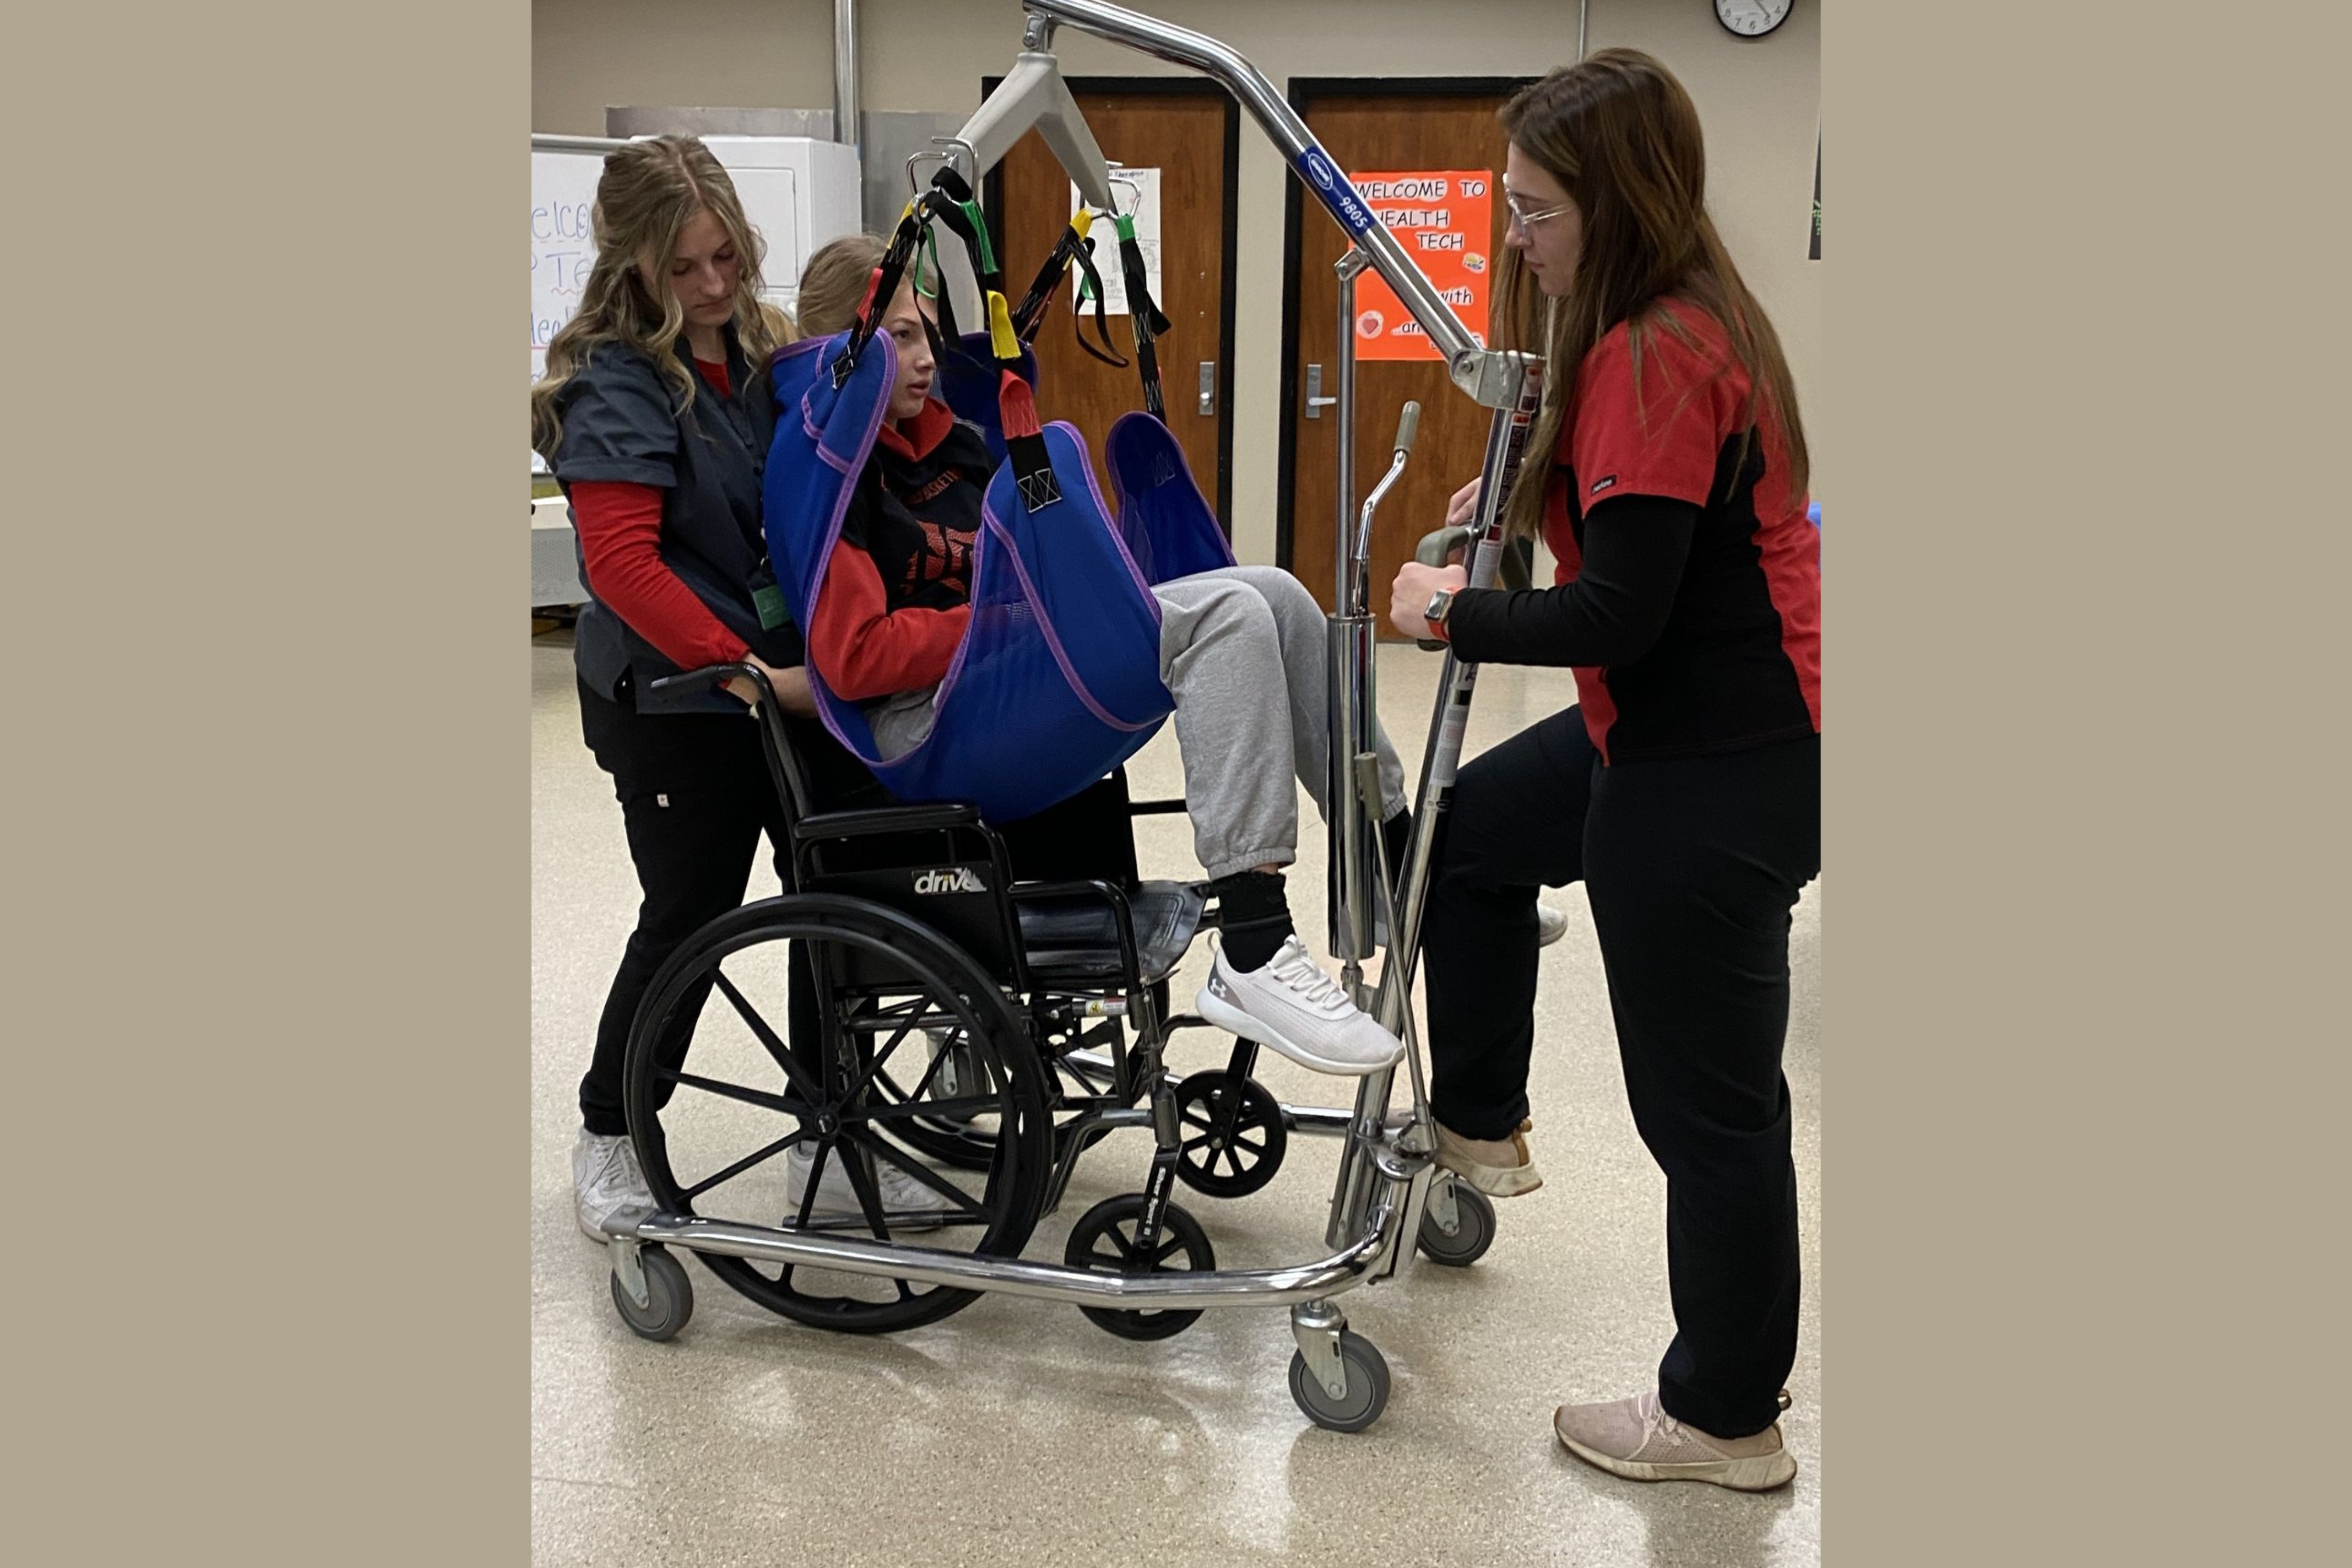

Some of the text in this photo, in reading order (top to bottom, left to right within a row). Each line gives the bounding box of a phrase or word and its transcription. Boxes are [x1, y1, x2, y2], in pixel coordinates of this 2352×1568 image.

[1736, 17, 1742, 26] 7
[1749, 20, 1756, 30] 6
[1355, 181, 1485, 199] WELCOME TO
[1339, 197, 1368, 227] 9805
[1417, 235, 1462, 249] TECH
